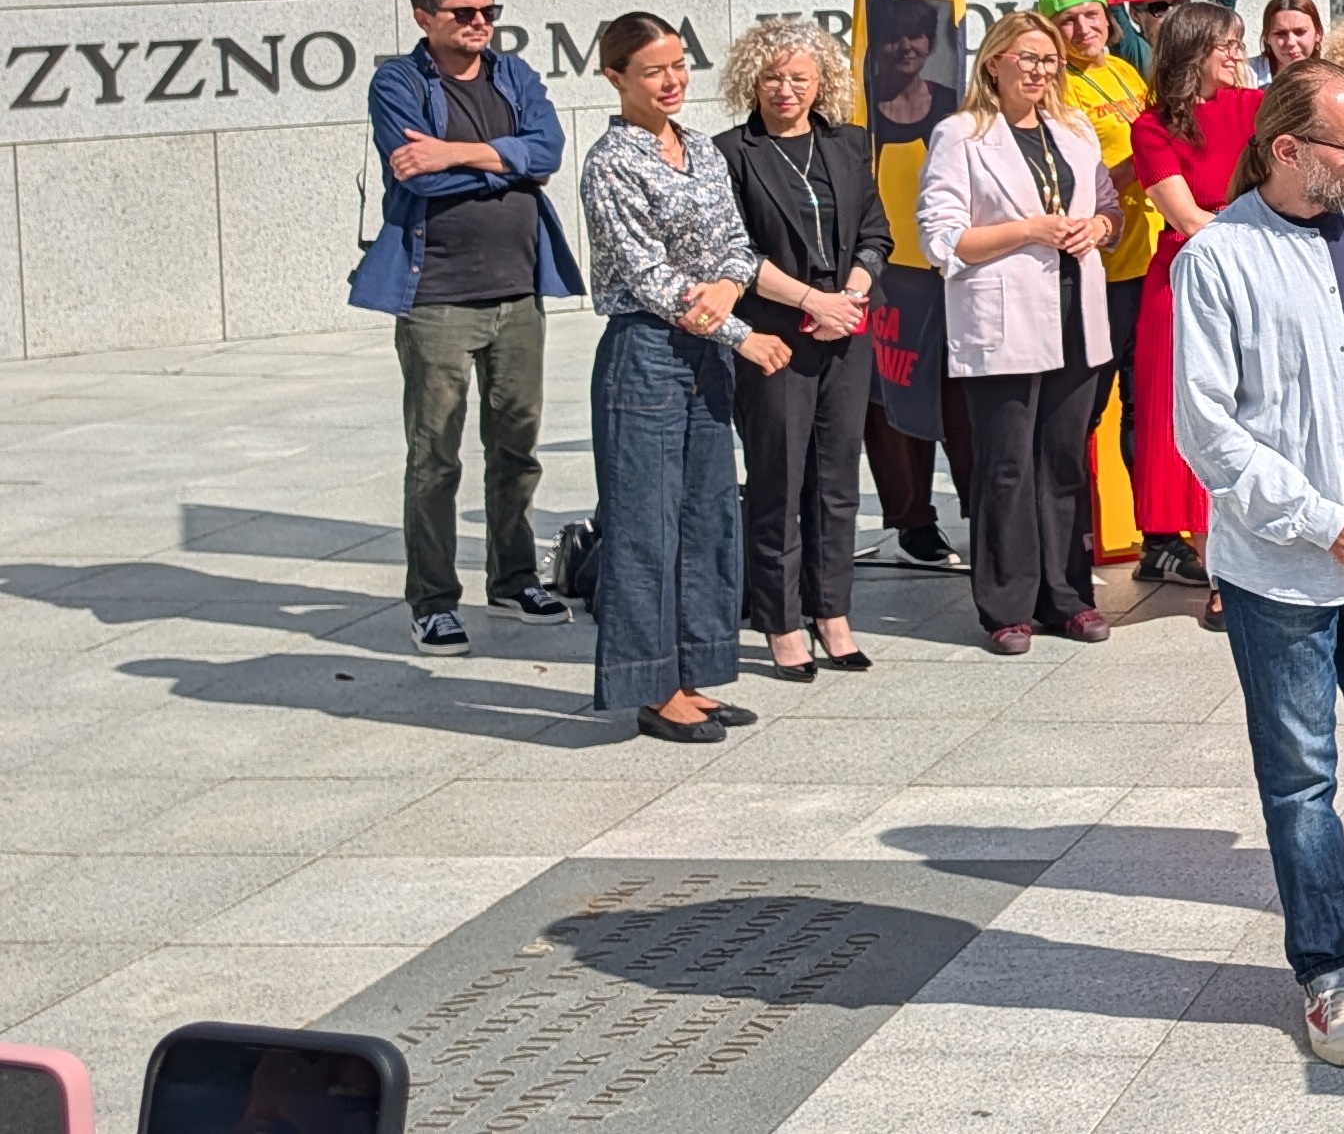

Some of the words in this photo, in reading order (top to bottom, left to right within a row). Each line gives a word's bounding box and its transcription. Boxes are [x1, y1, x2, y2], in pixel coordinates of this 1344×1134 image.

[582, 985, 759, 1105] POLSKIEGO
[687, 933, 884, 1075] PODZIEMNEGO
[479, 1051, 614, 1133] OMNIK
